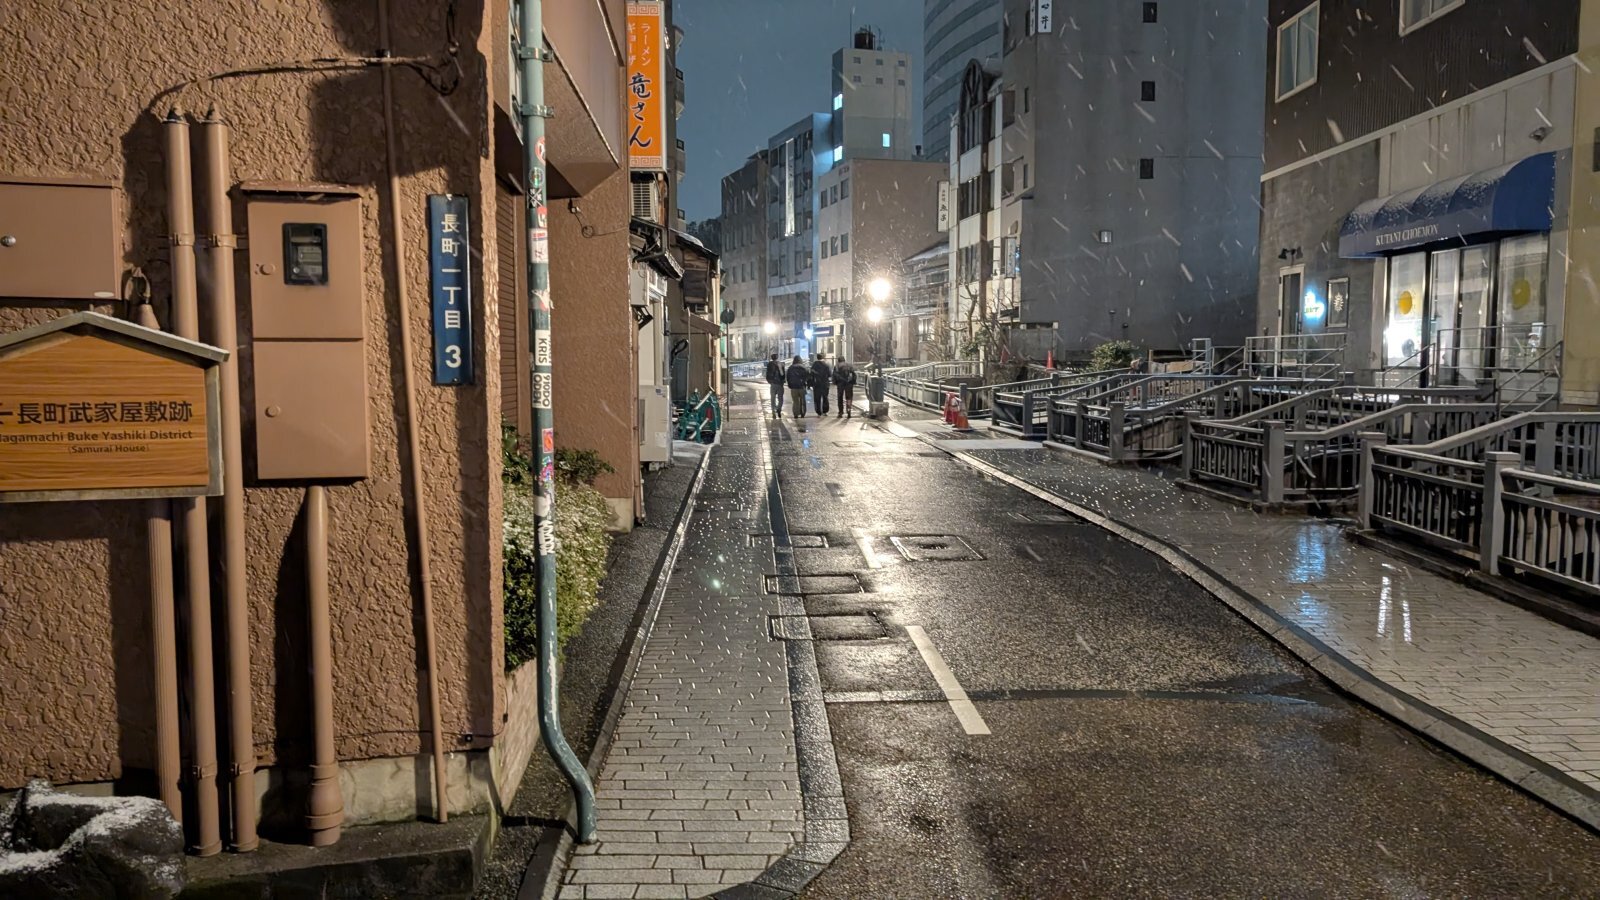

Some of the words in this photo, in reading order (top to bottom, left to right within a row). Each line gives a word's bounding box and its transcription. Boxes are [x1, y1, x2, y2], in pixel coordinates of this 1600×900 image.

[628, 22, 637, 66] ギョーザ
[640, 23, 651, 66] ラーメン
[628, 72, 651, 148] 竜さん
[1375, 231, 1401, 246] KUTANI
[1402, 223, 1439, 241] CHOEMON
[441, 213, 461, 329] 長町一丁目
[445, 345, 462, 369] 3
[538, 338, 548, 363] KRIS
[17, 400, 193, 424] 長町武家屋敷跡
[67, 431, 99, 442] Buke
[102, 430, 147, 441] Yashiki
[150, 429, 193, 440] District
[68, 444, 113, 455] (Samurai
